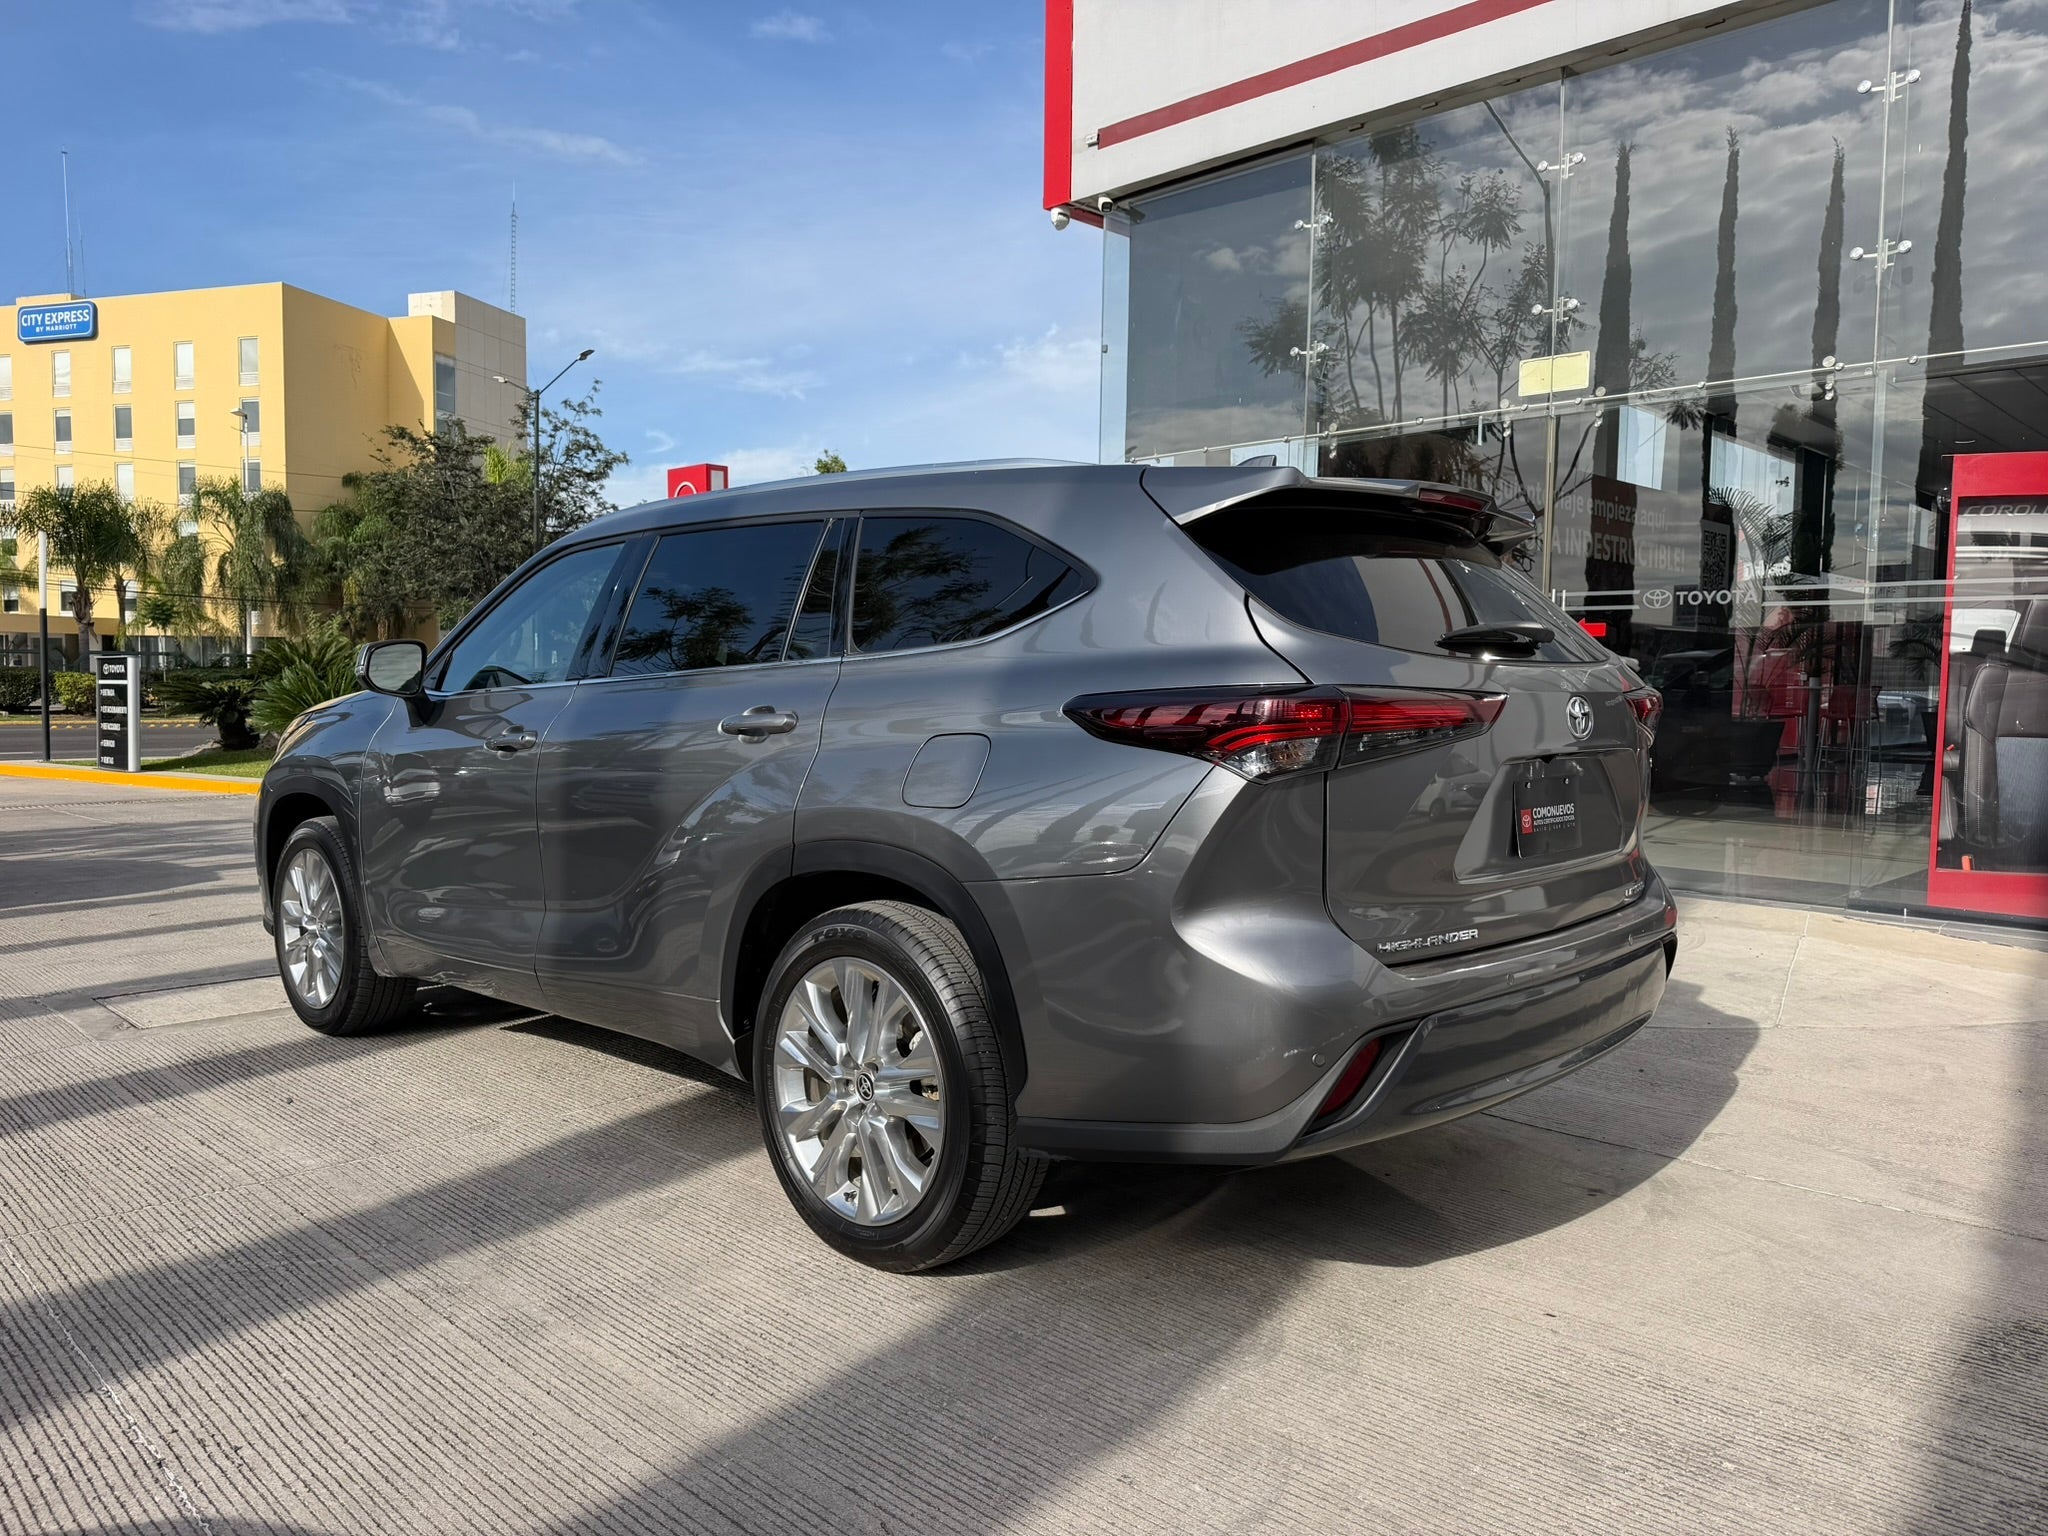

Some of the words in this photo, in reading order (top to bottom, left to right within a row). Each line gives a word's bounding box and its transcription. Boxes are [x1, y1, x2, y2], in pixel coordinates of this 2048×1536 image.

[21, 314, 42, 327] CITY
[45, 309, 89, 325] EXPRESS
[1586, 496, 1637, 525] empieza
[1675, 589, 1758, 606] TOYOTA
[1532, 803, 1574, 818] COMONUEVOS
[1377, 928, 1479, 953] HIGHLANDER
